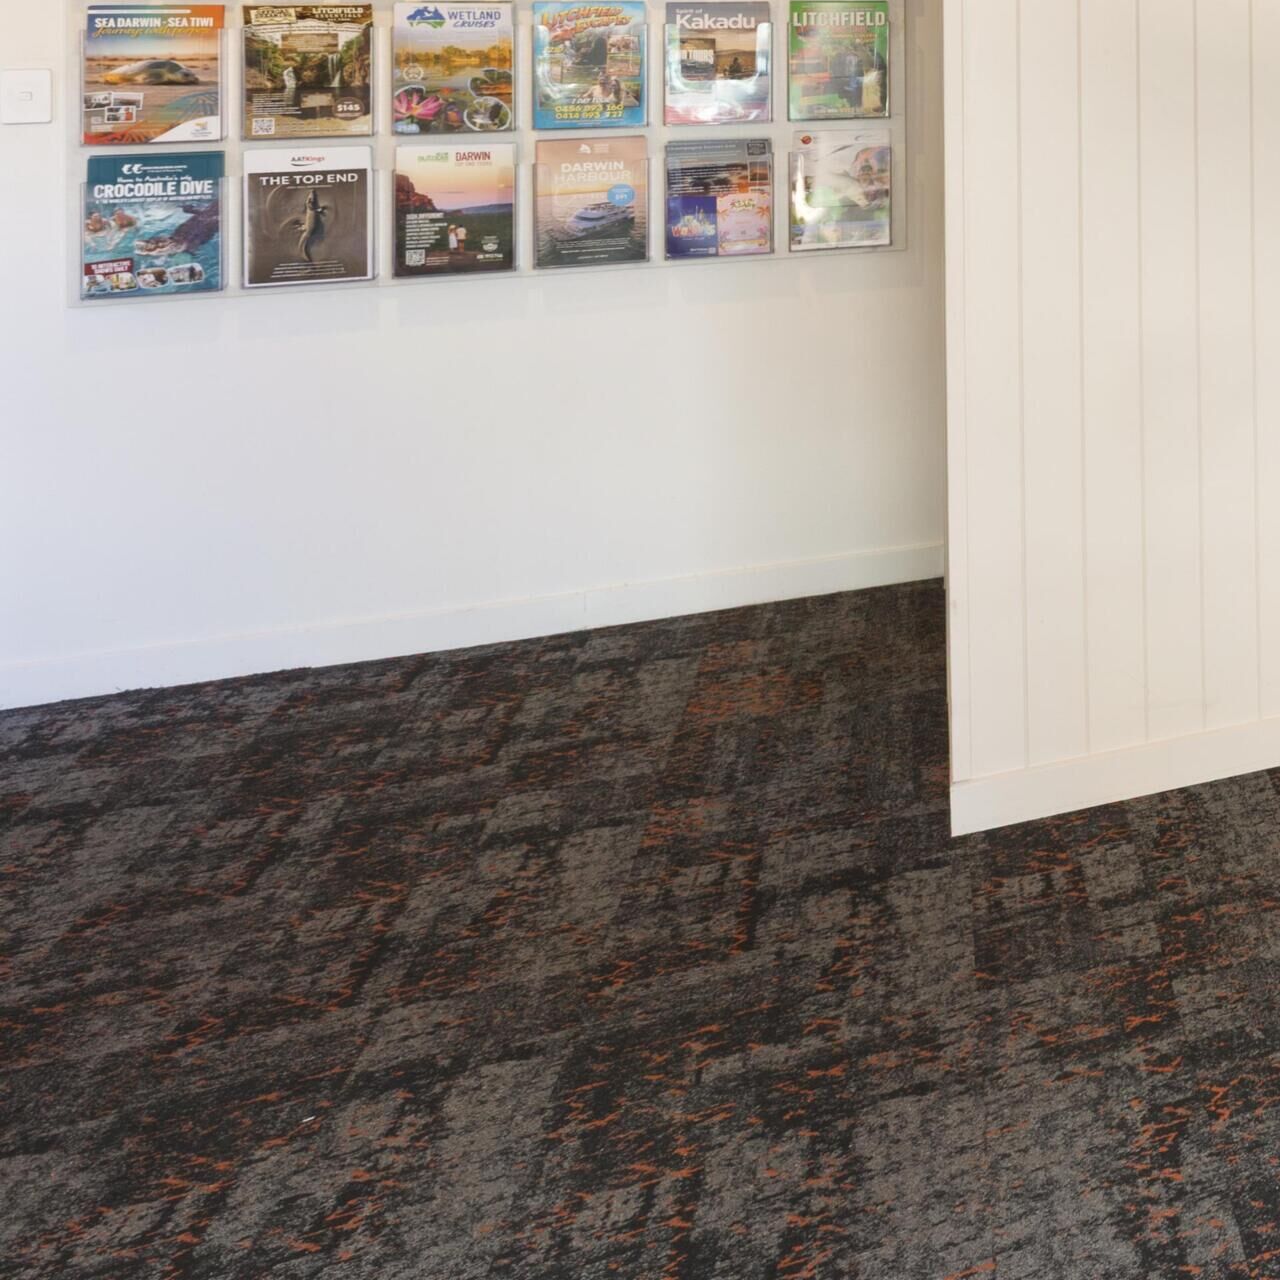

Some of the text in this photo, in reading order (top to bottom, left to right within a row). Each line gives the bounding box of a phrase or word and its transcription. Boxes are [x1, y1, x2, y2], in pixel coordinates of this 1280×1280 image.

[448, 11, 501, 20] WETLAND
[541, 6, 624, 30] LITCHFIELD
[675, 13, 755, 29] Kakadu
[792, 11, 886, 26] LITCHFIELD
[95, 17, 213, 28] SEA DARWIN SEA TIWI
[453, 20, 495, 28] CRUISES
[455, 151, 491, 161] DARWIN
[561, 161, 624, 173] DARWIN
[260, 173, 358, 186] THE TOP END
[554, 170, 631, 185] HARBOUR
[94, 181, 177, 199] CROCODILE
[180, 180, 213, 195] DIVE
